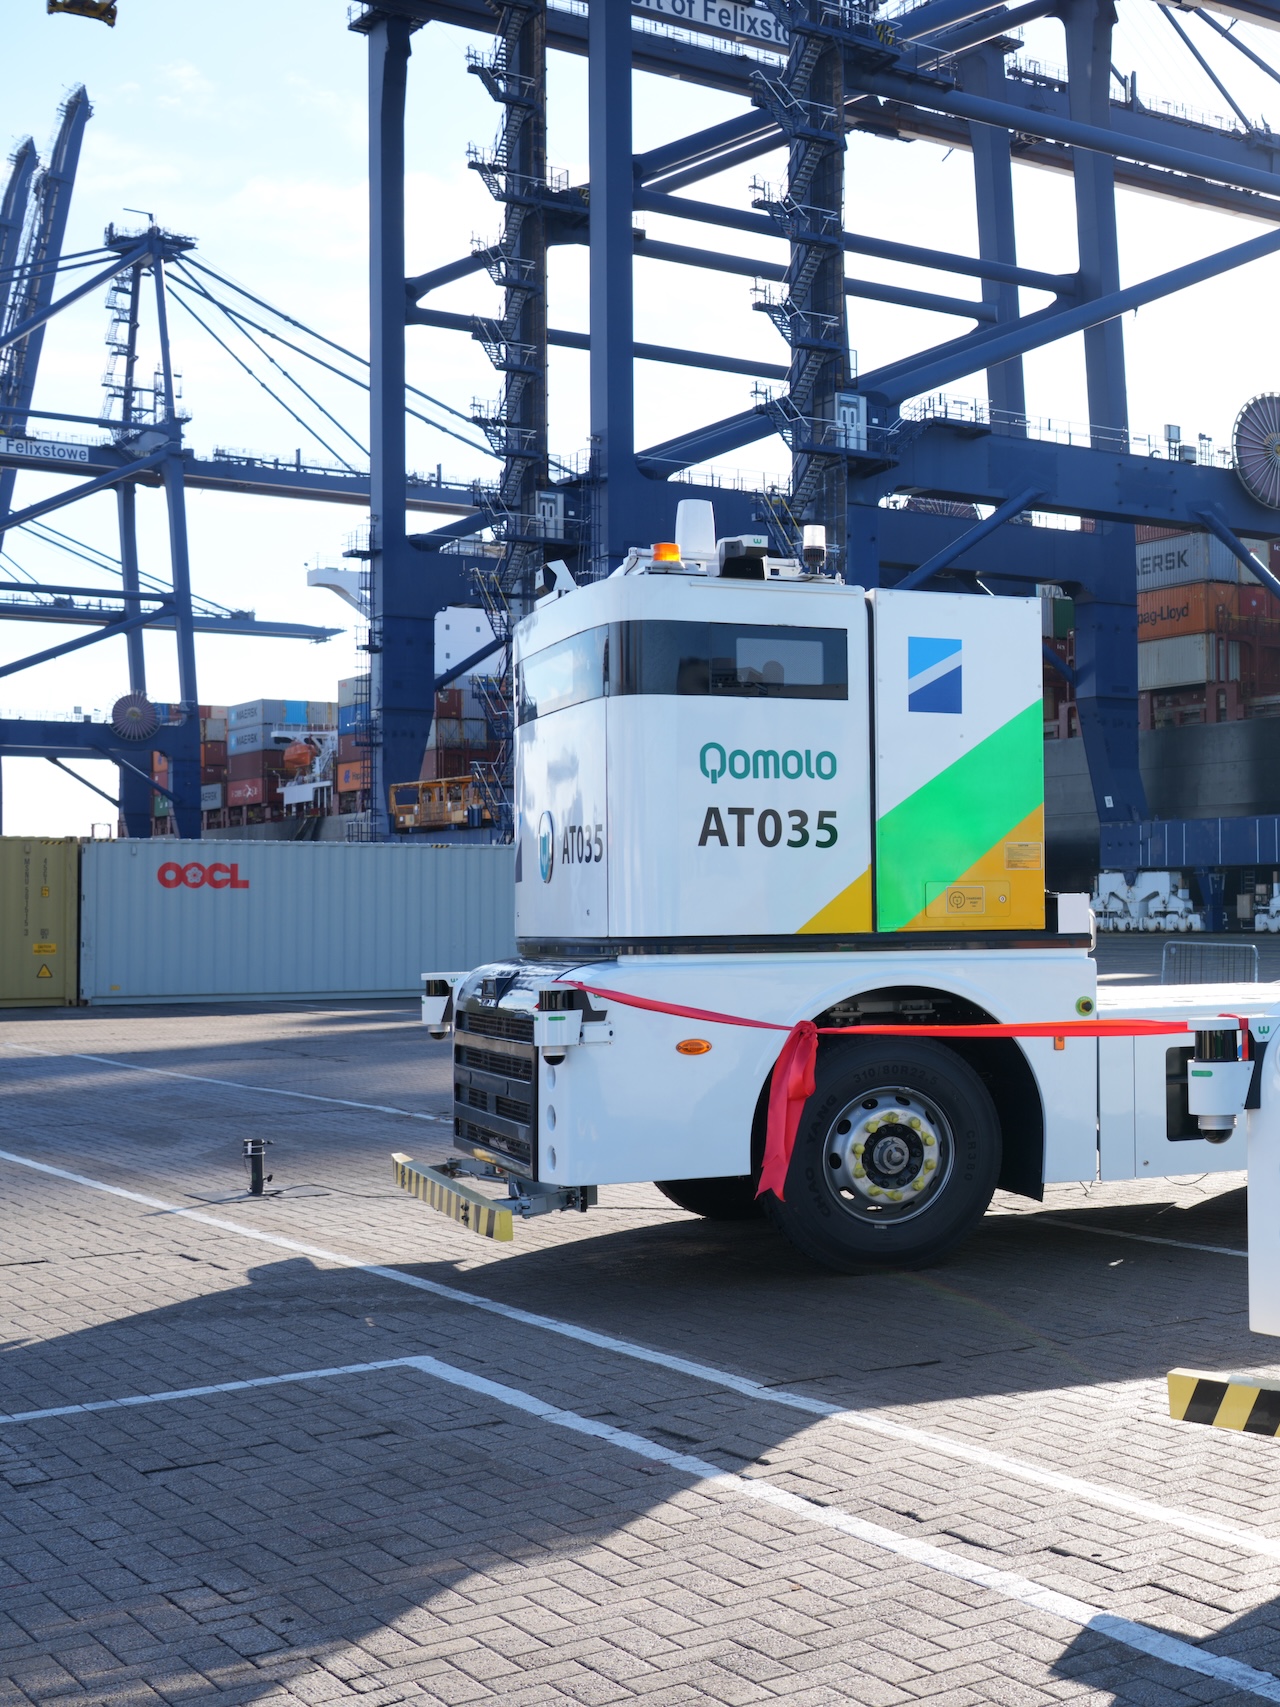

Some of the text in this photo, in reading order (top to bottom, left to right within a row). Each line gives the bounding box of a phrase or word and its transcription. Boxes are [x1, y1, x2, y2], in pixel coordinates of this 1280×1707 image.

[6, 439, 87, 460] Felixstowe
[700, 742, 837, 784] Qomolo
[562, 824, 603, 864] AT035
[698, 807, 838, 848] AT035
[157, 862, 249, 889] OOCL
